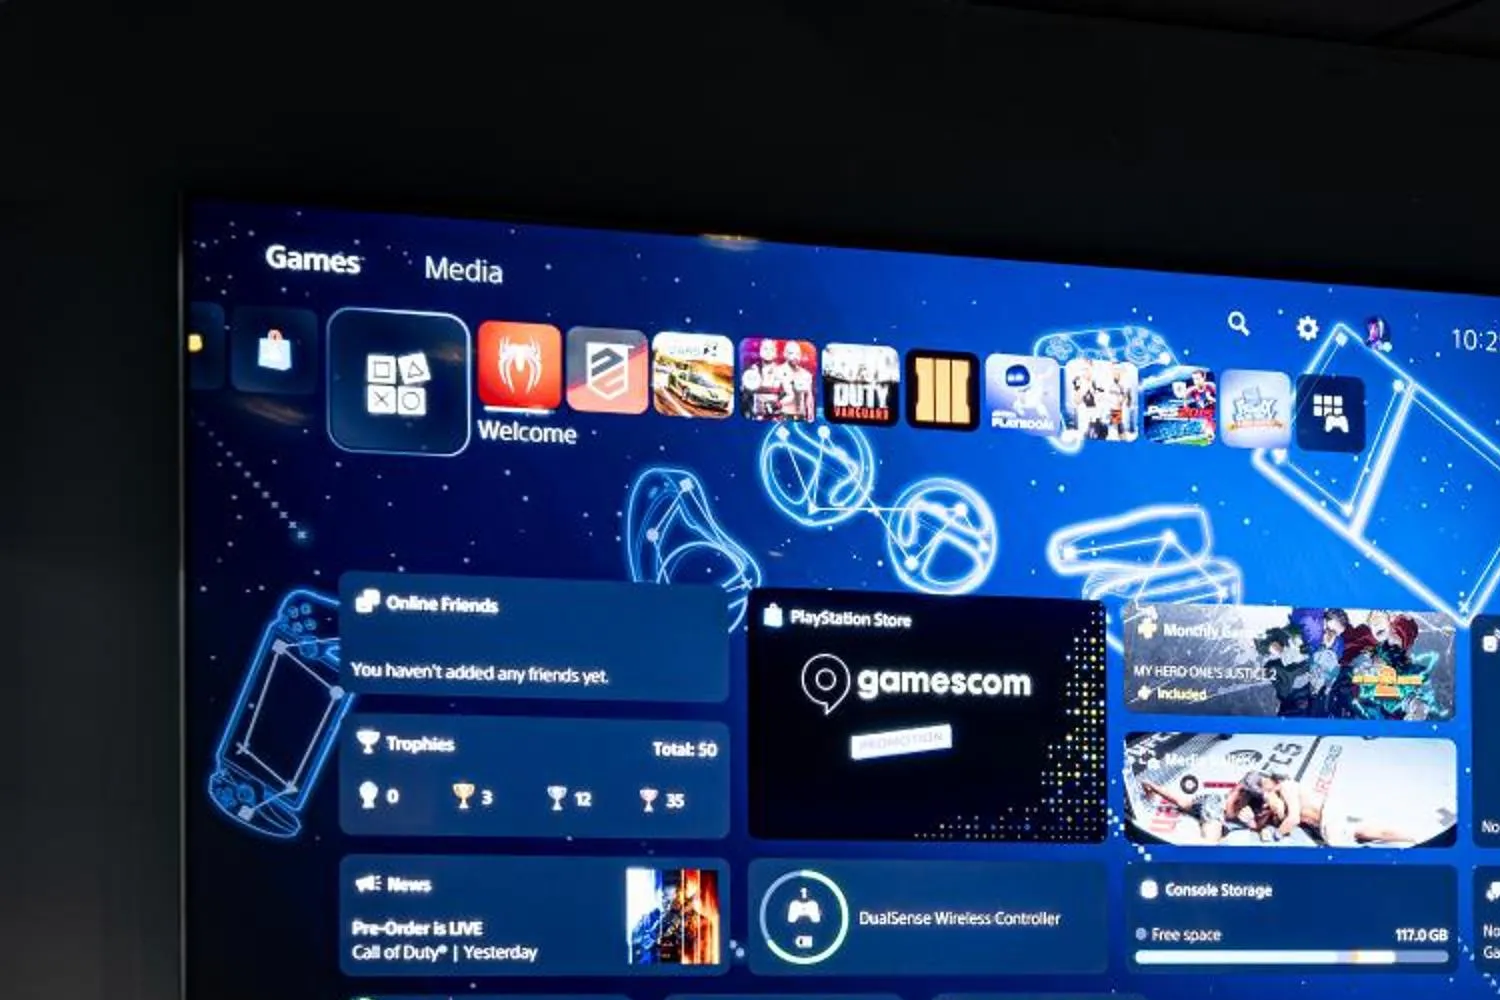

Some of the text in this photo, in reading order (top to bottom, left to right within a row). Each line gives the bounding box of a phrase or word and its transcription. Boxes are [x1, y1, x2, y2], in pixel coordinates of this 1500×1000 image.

[266, 245, 360, 274] Games
[426, 256, 503, 284] Media
[833, 383, 889, 408] DUTY
[477, 420, 577, 444] Welcome
[386, 595, 499, 613] Online Friends
[790, 609, 912, 627] PlayStation Store
[1163, 622, 1220, 641] Monthly
[351, 662, 608, 685] You haven't added any friends yet.
[1134, 665, 1153, 677] MY
[1156, 666, 1187, 678] HERO
[1189, 667, 1223, 679] ONE'S
[857, 670, 1031, 700] gamescom
[1157, 688, 1207, 700] Included
[386, 736, 455, 754] Trophies
[653, 742, 718, 757] Total: 50
[387, 789, 399, 804] 0
[482, 790, 492, 805] 3
[575, 792, 591, 806] 12
[666, 794, 684, 808] 35
[1482, 820, 1500, 833] No
[388, 877, 432, 892] News
[1166, 883, 1272, 899] Console Storage
[860, 911, 1060, 926] DualSense Wireless Controller
[352, 920, 482, 936] Pre-Order is LIVE
[1152, 928, 1221, 943] Free space
[1396, 928, 1448, 942] 117.0 GB
[1484, 925, 1500, 937] No
[352, 944, 380, 960] Call
[384, 945, 401, 960] of
[463, 945, 538, 962] Yesterday
